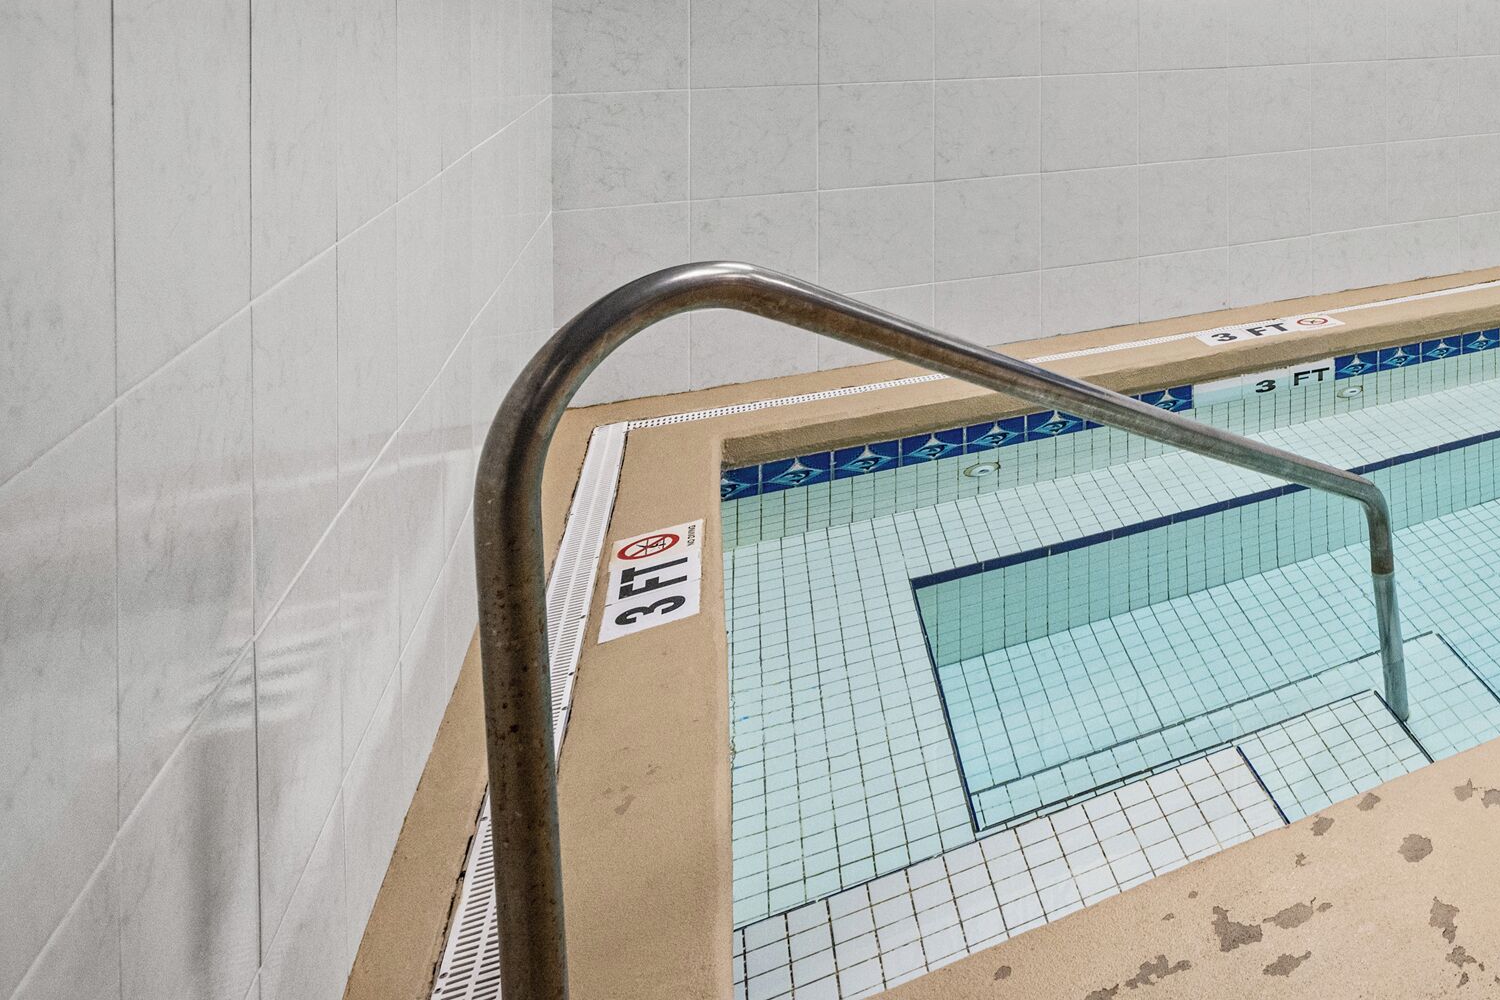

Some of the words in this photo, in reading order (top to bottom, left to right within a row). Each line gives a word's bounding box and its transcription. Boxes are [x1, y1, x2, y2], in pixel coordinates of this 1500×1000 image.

[1211, 333, 1237, 342] 3
[1247, 323, 1288, 336] FT
[1256, 379, 1276, 393] 3
[1294, 367, 1330, 386] FT
[619, 557, 688, 600] FT
[615, 595, 686, 625] 3
